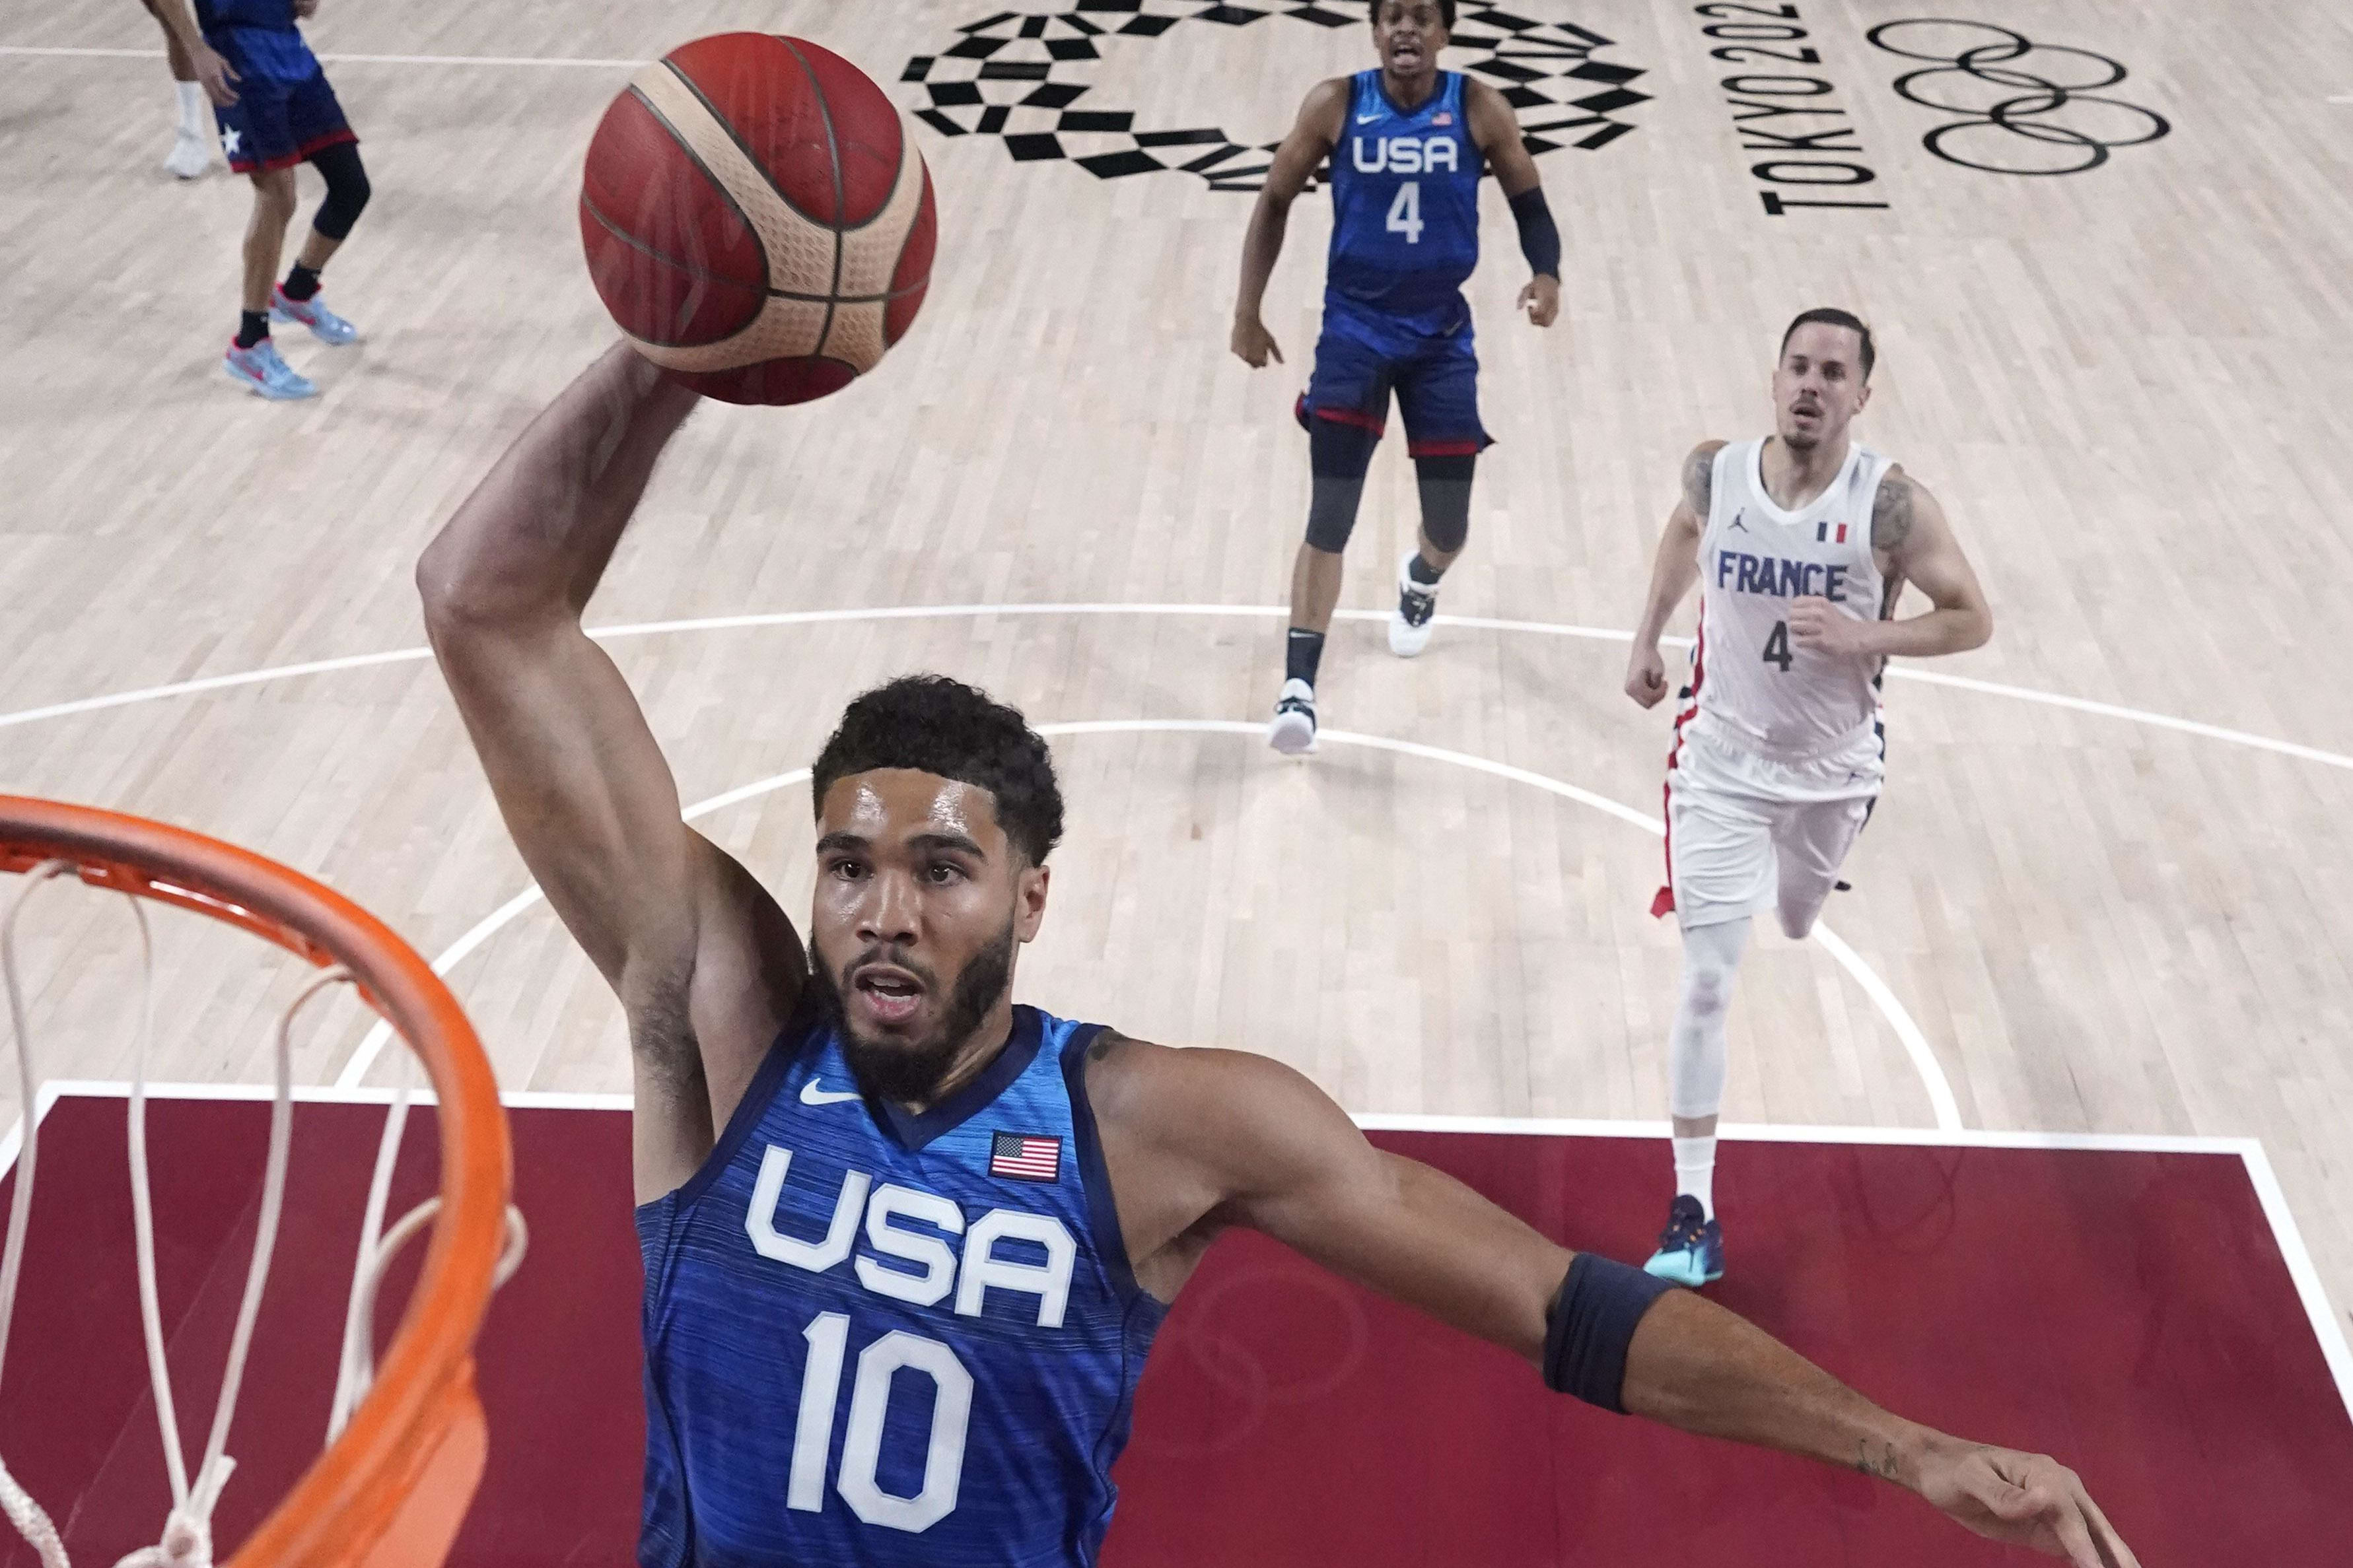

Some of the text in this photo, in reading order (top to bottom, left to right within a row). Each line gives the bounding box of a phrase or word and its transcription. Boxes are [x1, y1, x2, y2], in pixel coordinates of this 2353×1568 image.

[1352, 136, 1458, 174] USA
[1720, 74, 1889, 215] TOKYO
[1386, 181, 1424, 244] 4
[1718, 550, 1848, 602] FRANCE
[1762, 620, 1793, 673] 4
[744, 1143, 1077, 1329] USA
[786, 1311, 975, 1534] 10
